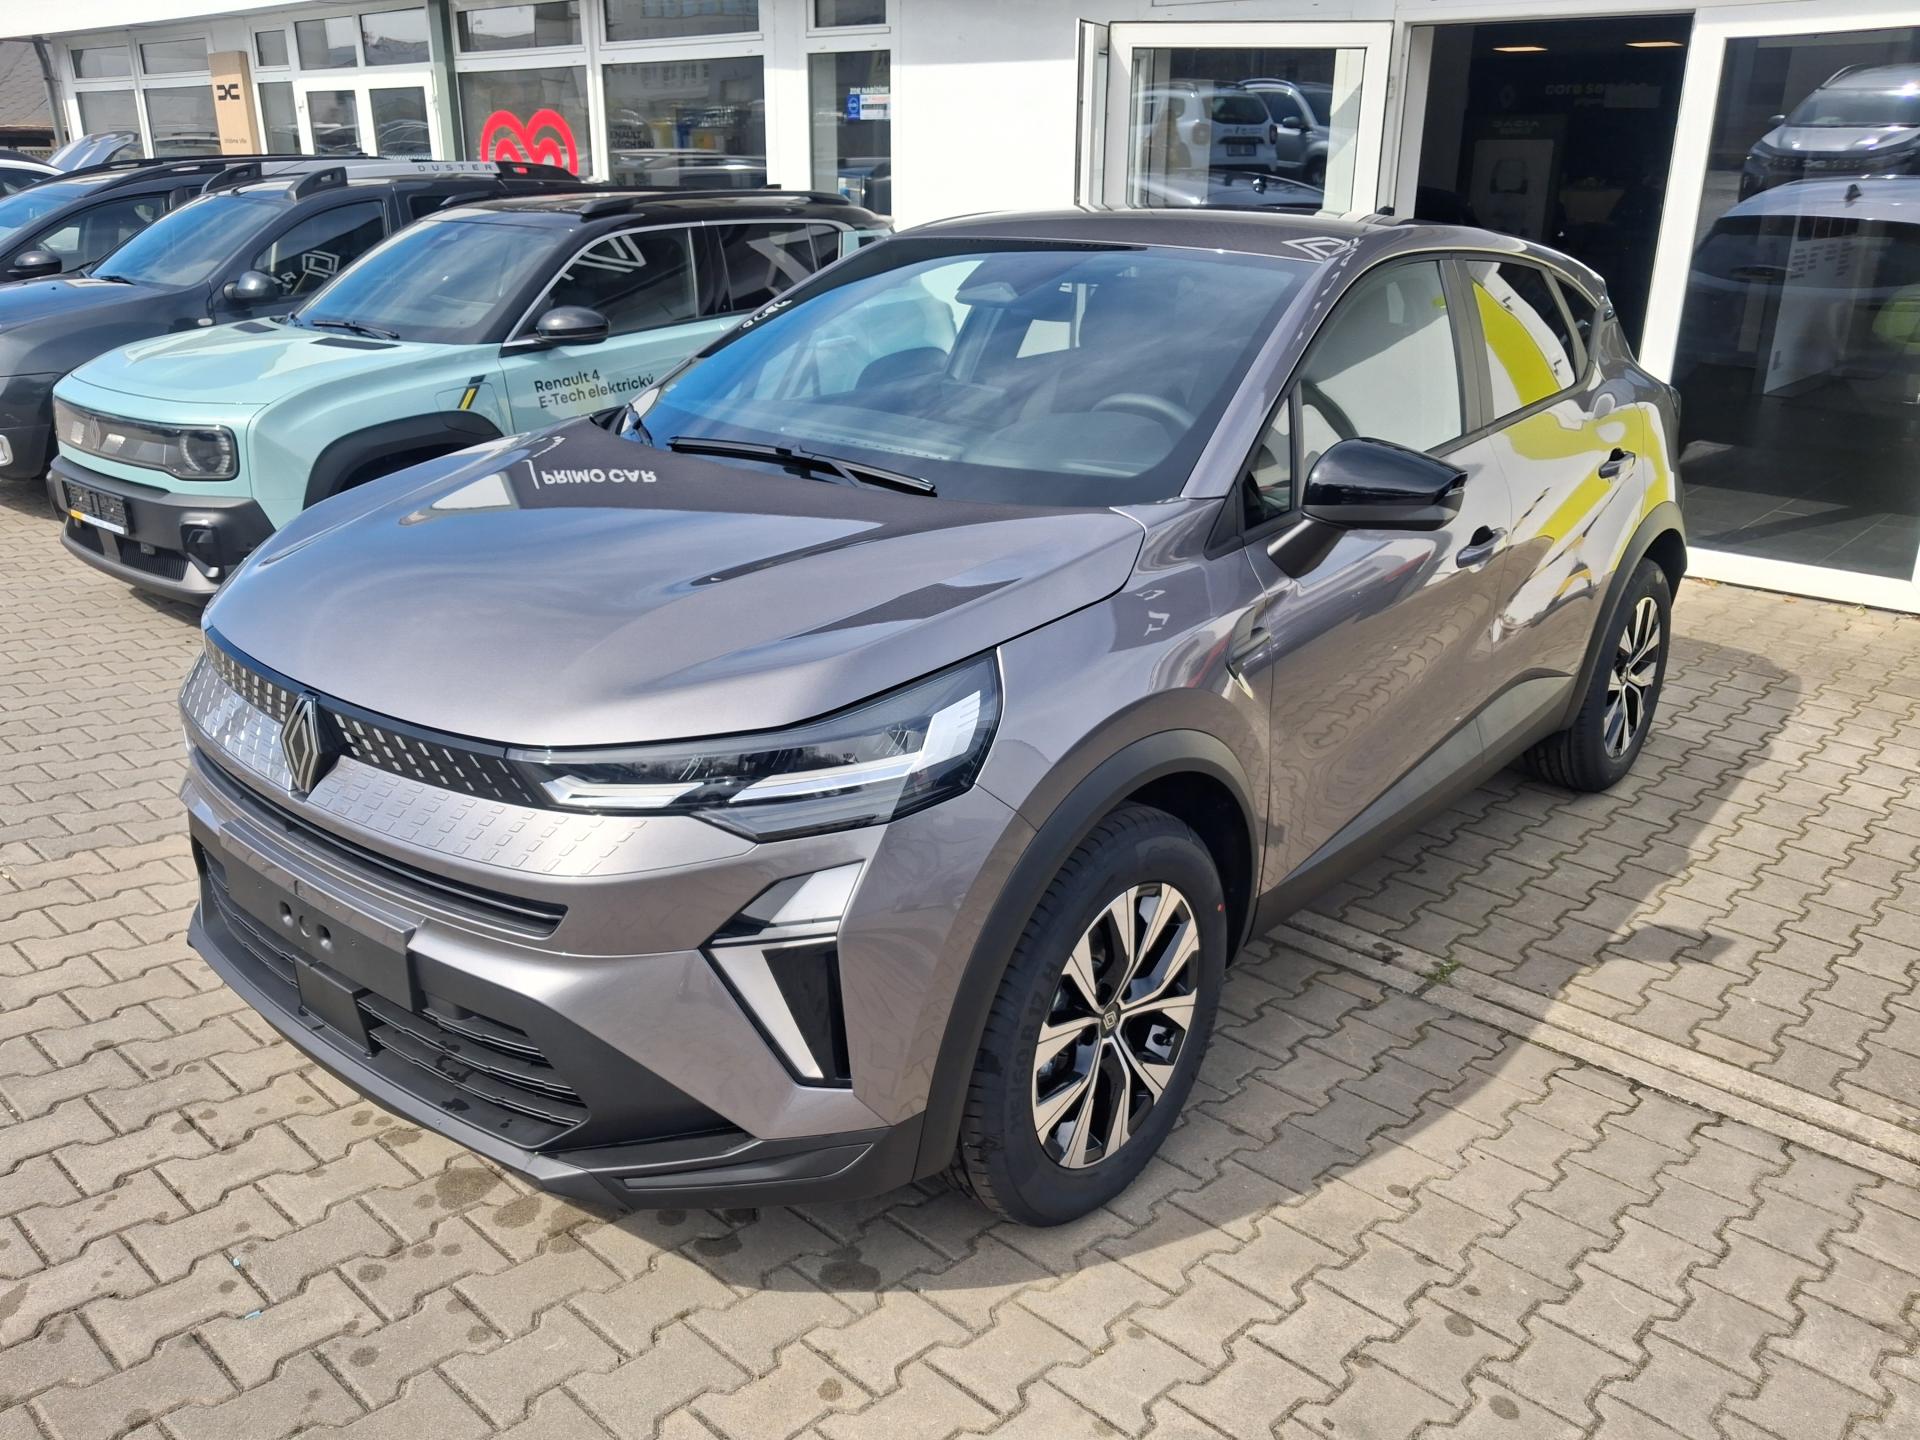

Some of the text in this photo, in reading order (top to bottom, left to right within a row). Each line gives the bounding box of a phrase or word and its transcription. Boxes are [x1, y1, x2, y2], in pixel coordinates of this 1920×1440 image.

[417, 164, 493, 172] DUSTER
[534, 369, 600, 393] Renault 4
[539, 389, 586, 409] E-Tech
